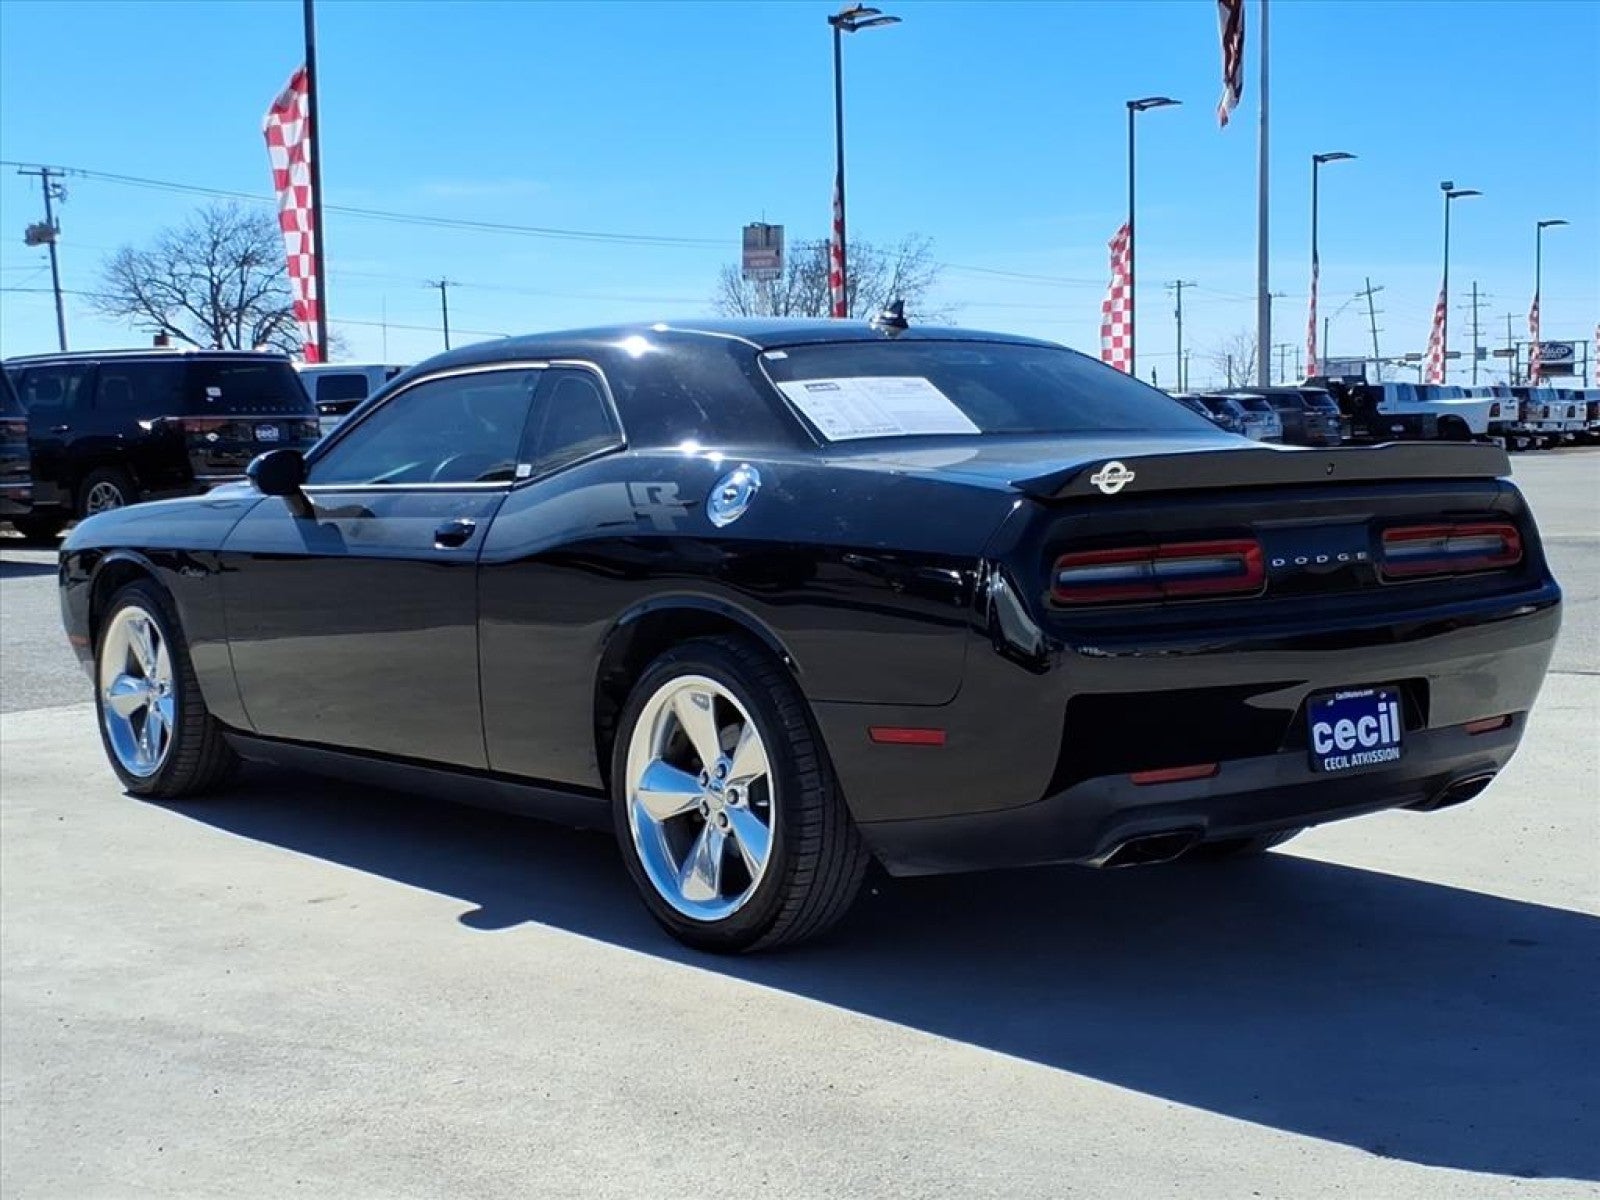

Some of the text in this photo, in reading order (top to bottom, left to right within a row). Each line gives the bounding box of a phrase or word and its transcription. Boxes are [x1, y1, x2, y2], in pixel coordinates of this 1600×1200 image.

[1272, 551, 1367, 567] DODGE
[1313, 702, 1400, 754] cecil
[1324, 746, 1401, 771] CECIL ATKISSION
